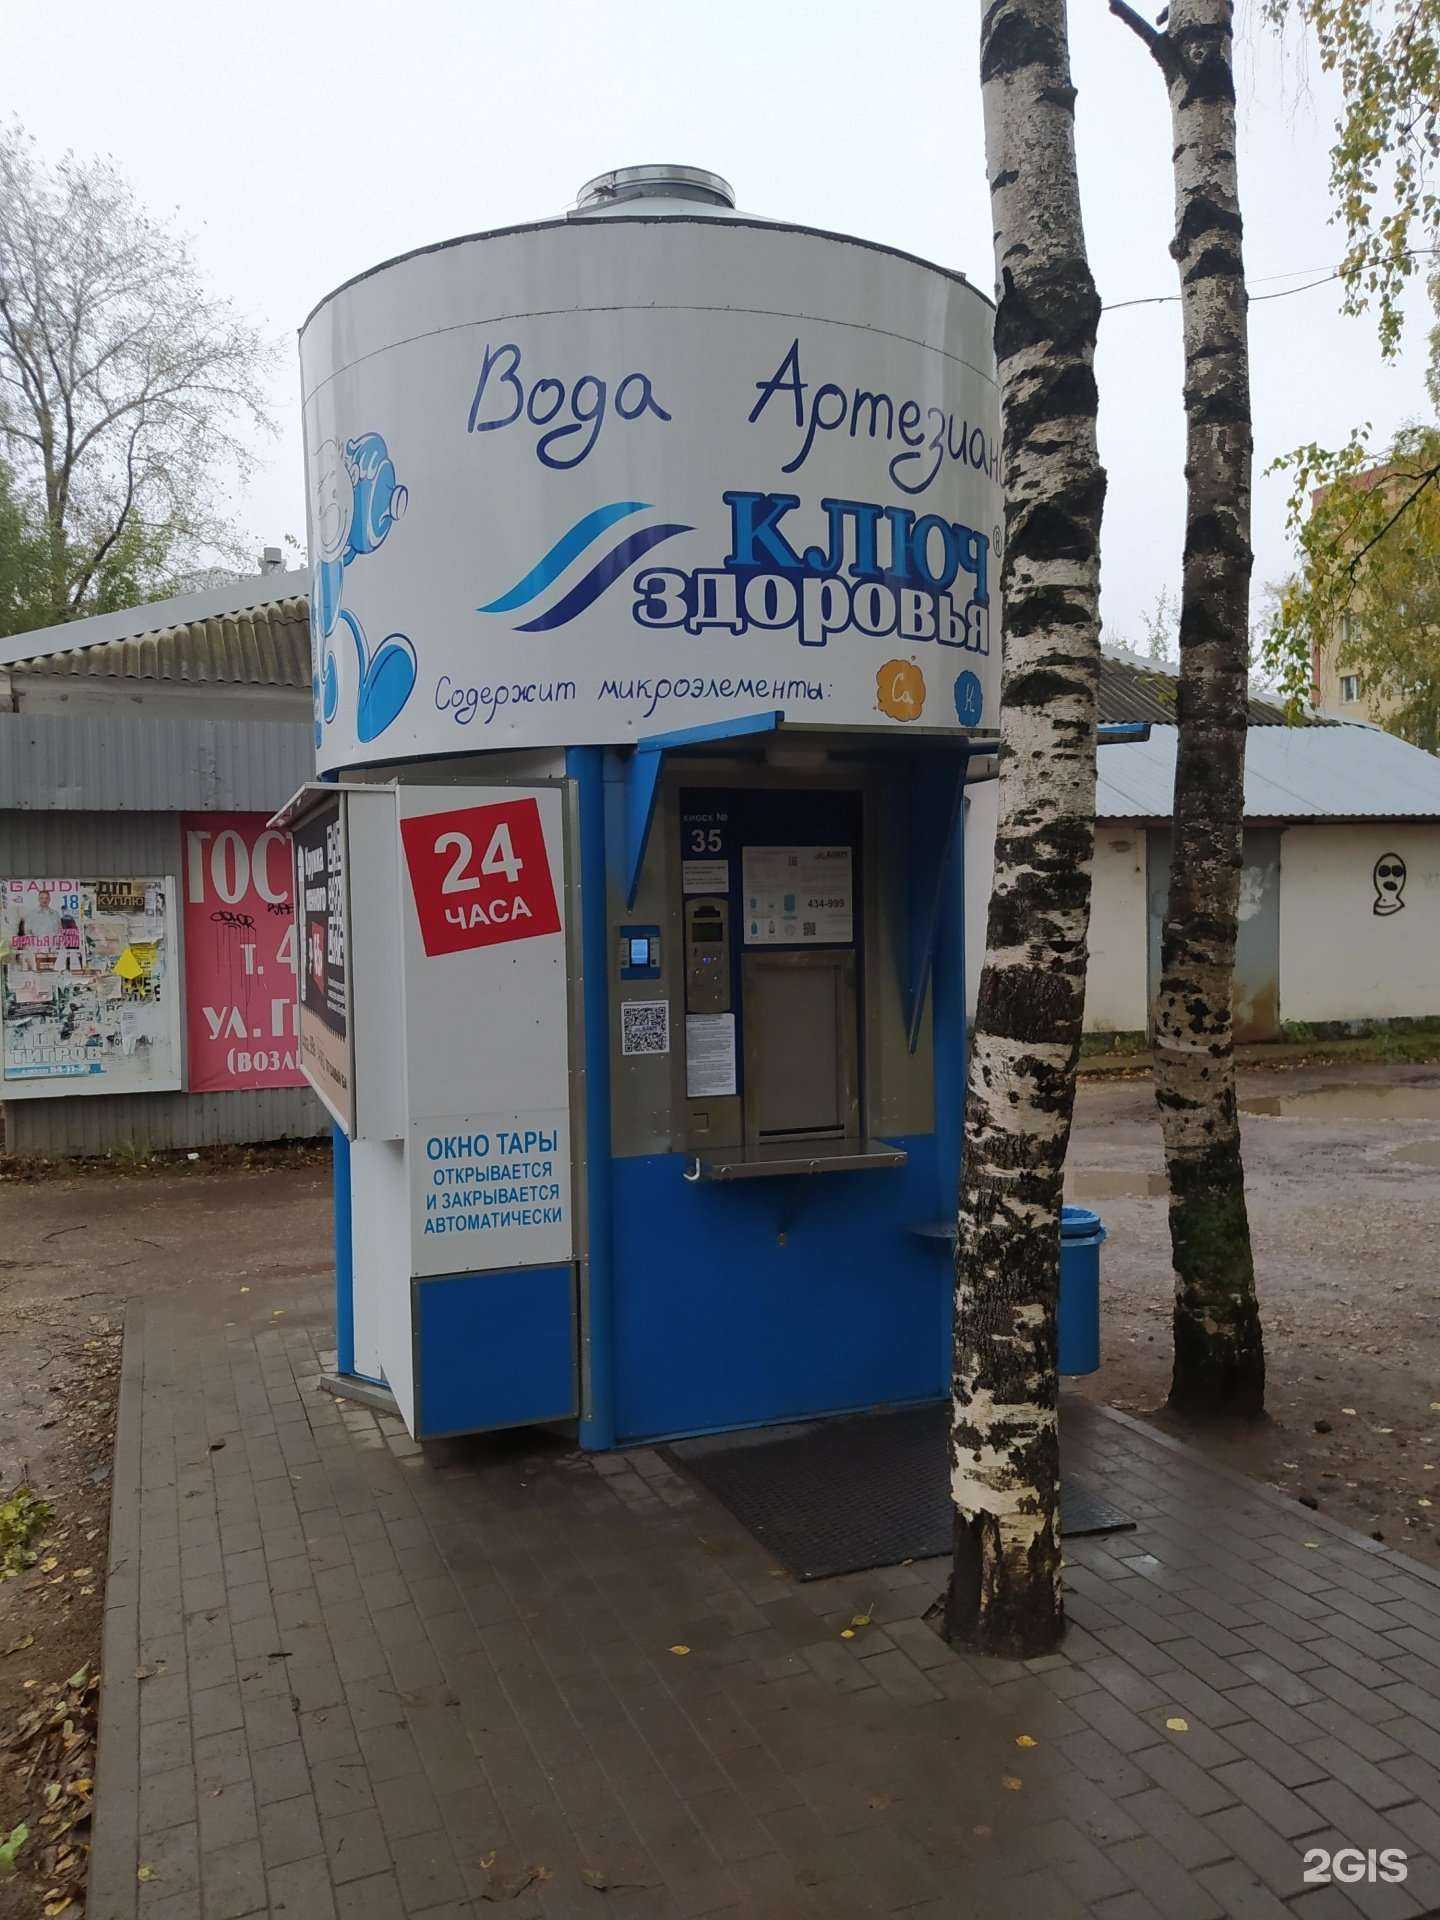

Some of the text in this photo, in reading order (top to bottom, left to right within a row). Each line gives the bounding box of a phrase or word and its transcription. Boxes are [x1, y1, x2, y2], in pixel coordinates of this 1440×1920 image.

[467, 343, 672, 469] Вода
[434, 674, 835, 726] Содержит микроэлементы:
[690, 828, 722, 852] 35
[186, 829, 293, 904] ГОС
[433, 822, 523, 894] 24
[10, 880, 79, 892] GAUDI
[62, 895, 79, 910] 18
[97, 895, 144, 906] КУПЛЮ
[444, 895, 533, 930] ЧАСА
[426, 1129, 558, 1161] ОКНО ТАРЫ
[433, 1161, 553, 1186] ОТКРЫВАЕТСЯ
[425, 1183, 560, 1210] И ЗАКРЫВАЕТСЯ
[423, 1207, 563, 1235] АВТОМАТИЧЕСКИ
